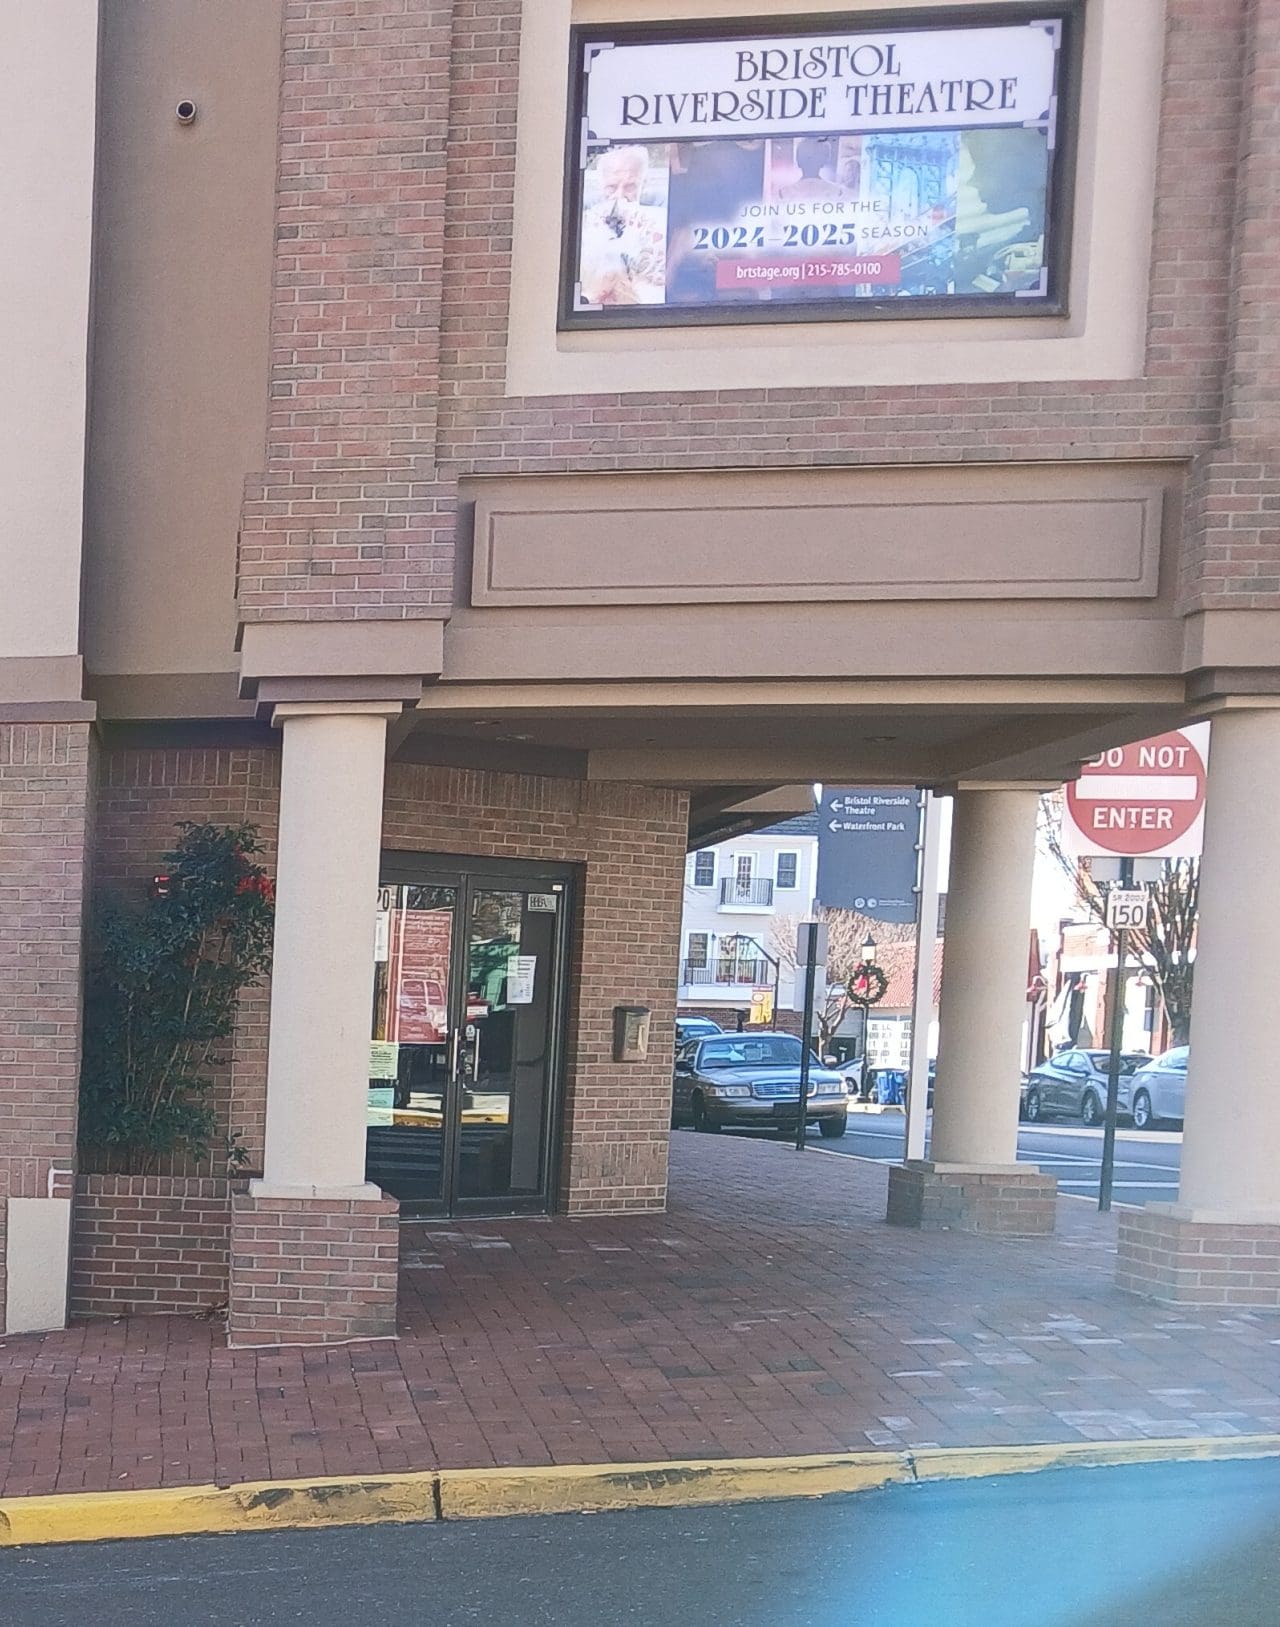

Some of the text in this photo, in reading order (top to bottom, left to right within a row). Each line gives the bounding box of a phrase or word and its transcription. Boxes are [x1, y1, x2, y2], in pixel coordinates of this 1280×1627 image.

[734, 43, 901, 82] BRISTOL
[620, 76, 1018, 126] RIVERSIDE THEATRE
[740, 200, 881, 218] JOIN US FOR THE
[861, 225, 929, 239] SEASON
[736, 265, 800, 280] brtstage.org
[807, 262, 881, 277] 215-785-0100
[1139, 746, 1191, 768] NOT
[844, 796, 911, 806] Bristol Riverside
[844, 806, 876, 815] Theatre
[1093, 806, 1174, 829] ENTER
[843, 821, 905, 831] Waterfront Park
[1111, 905, 1144, 927] 150
